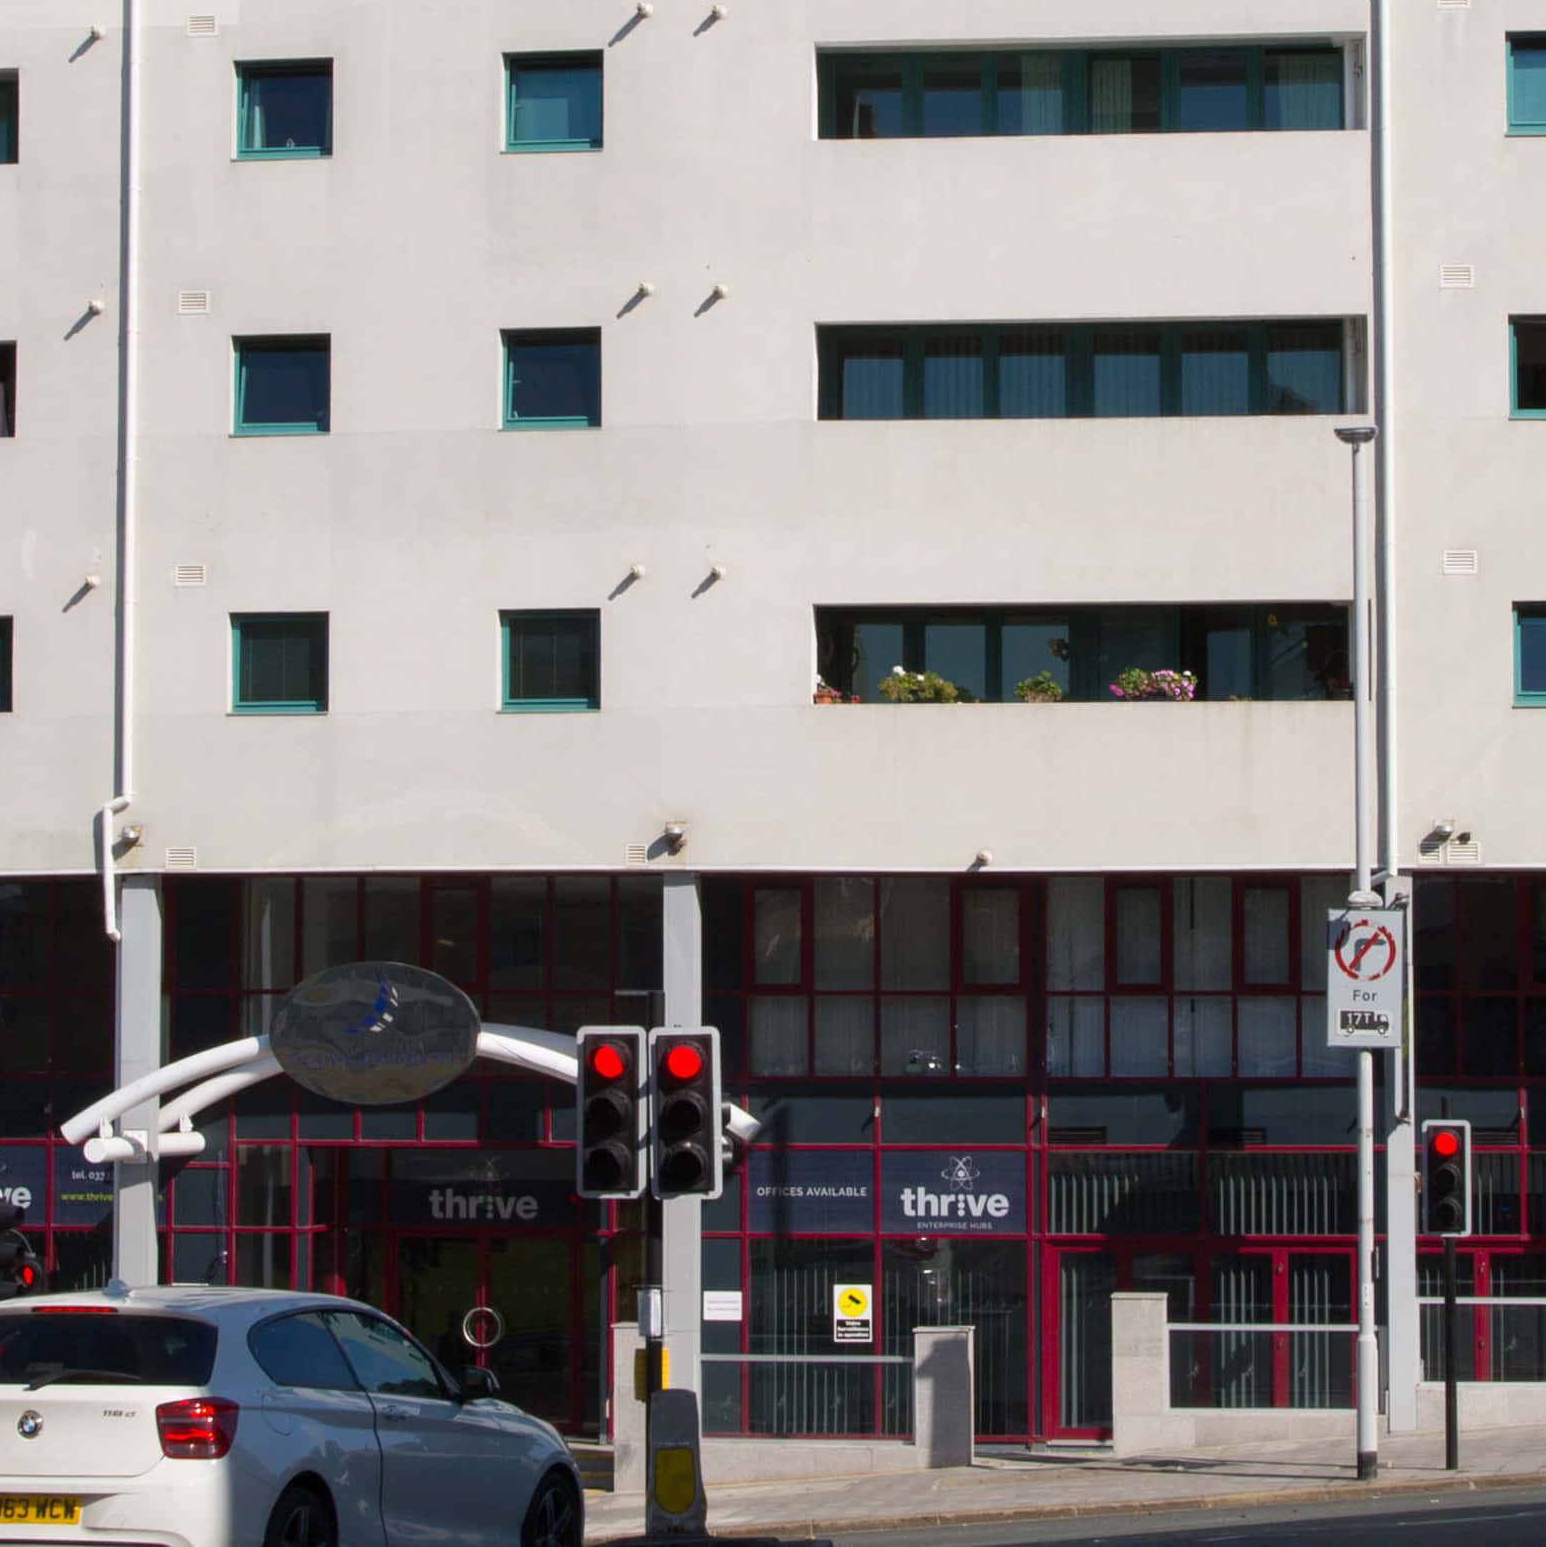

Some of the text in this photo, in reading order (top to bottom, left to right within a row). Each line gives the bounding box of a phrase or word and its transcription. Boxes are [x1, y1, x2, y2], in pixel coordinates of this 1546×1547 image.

[1353, 990, 1377, 1002] For
[1347, 1012, 1372, 1025] 17T
[756, 1187, 867, 1196] OFFICES AVAILABLE
[429, 1188, 539, 1220] thrive
[901, 1187, 1010, 1217] thrive
